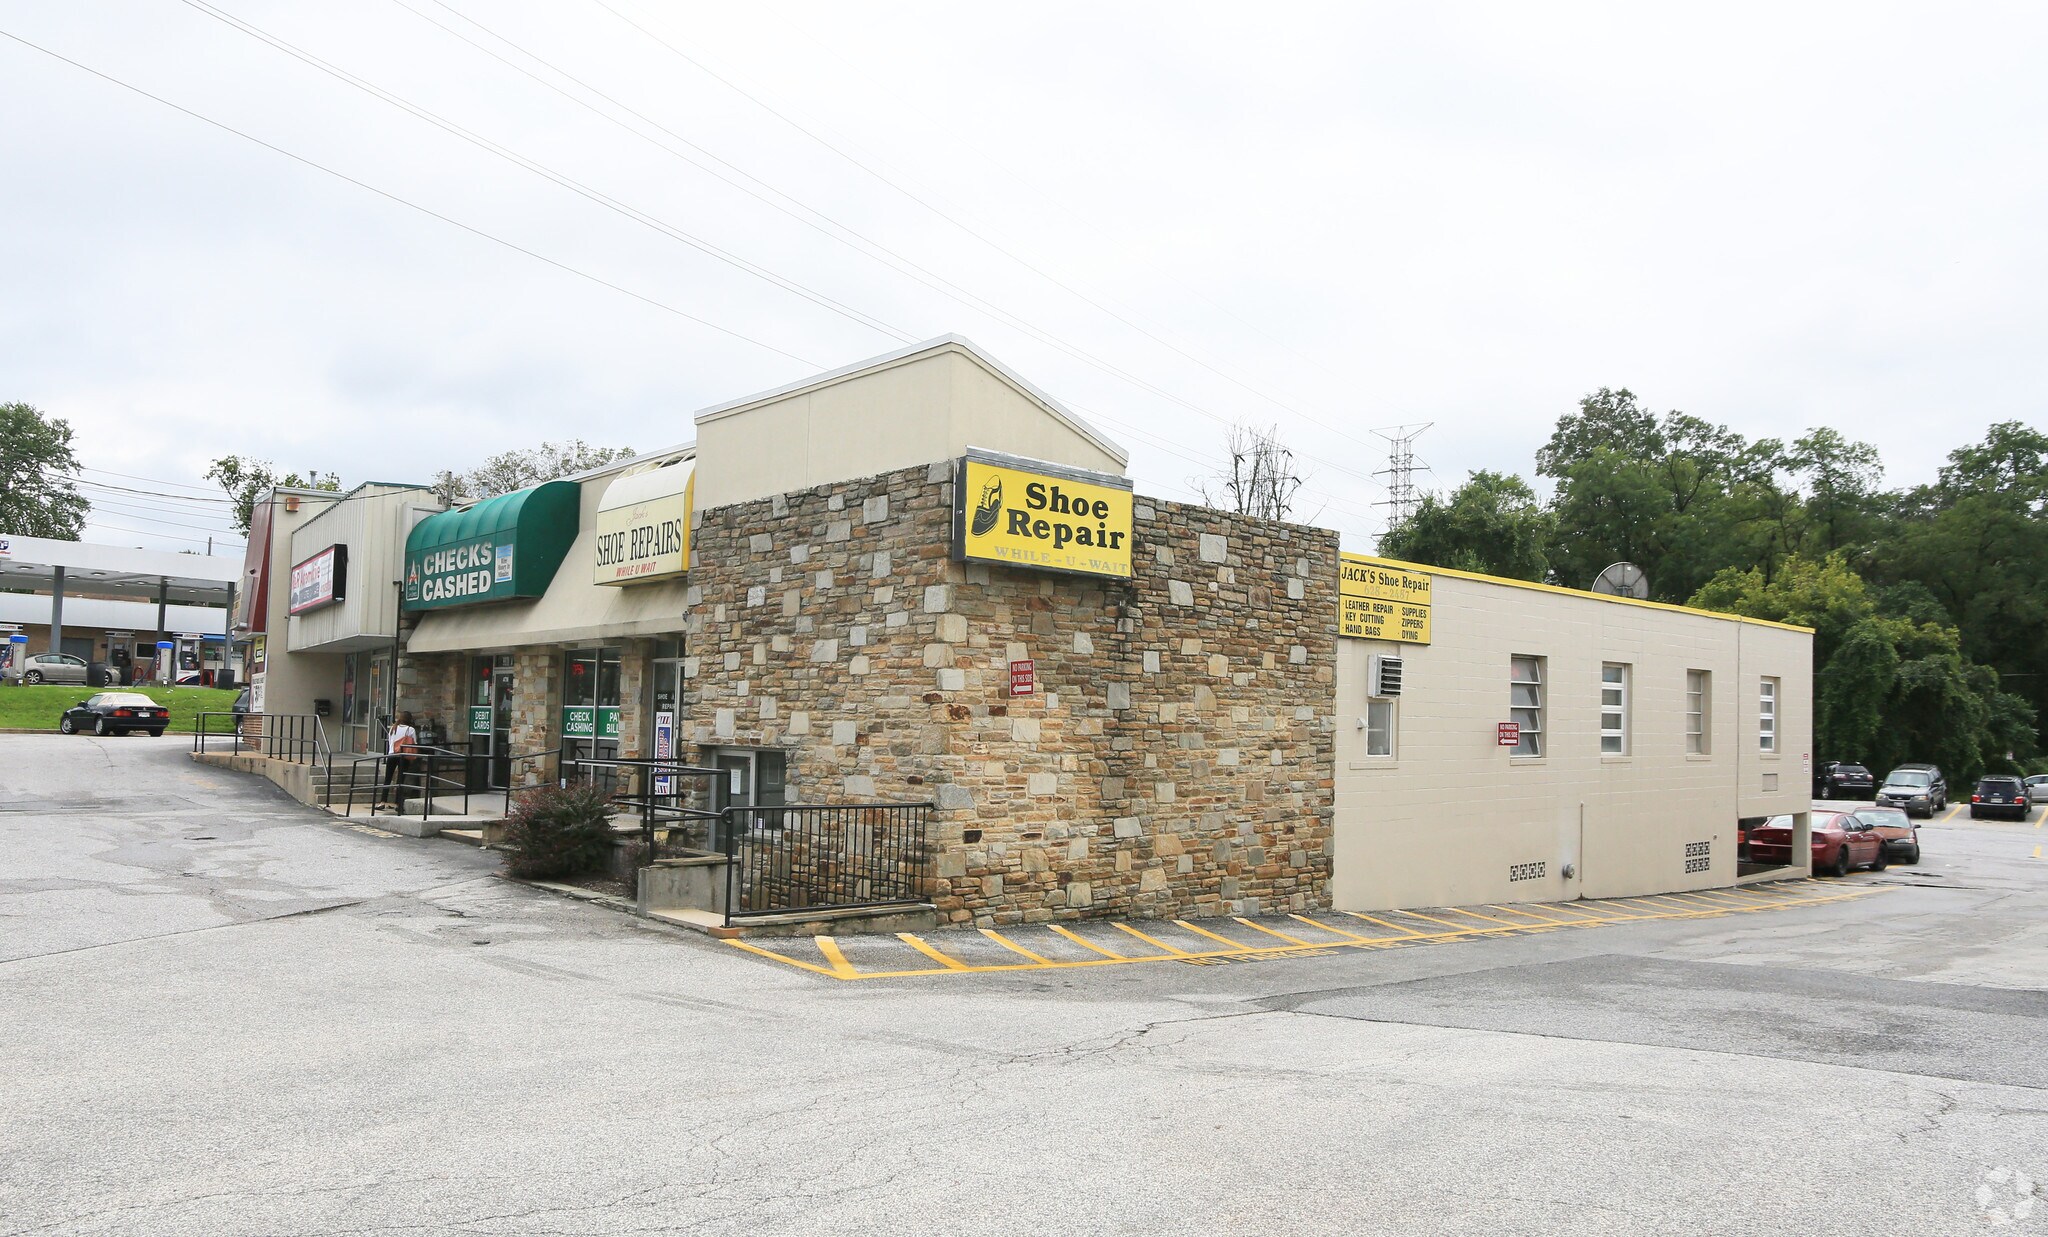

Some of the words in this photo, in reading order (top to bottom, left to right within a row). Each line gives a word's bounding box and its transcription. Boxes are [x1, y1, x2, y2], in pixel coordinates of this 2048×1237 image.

[1025, 482, 1109, 520] Shoe
[1006, 508, 1125, 550] Repair
[597, 532, 625, 567] SHOE
[630, 518, 682, 561] REPAIRS
[423, 541, 492, 576] CHECKS
[616, 565, 634, 577] WHILE
[641, 561, 657, 573] WAIT
[422, 570, 491, 601] CASHED
[1341, 567, 1376, 584] JACK'S
[1379, 573, 1399, 587] Shoe
[1402, 576, 1429, 593] Repair
[1345, 600, 1370, 612] LEATHER
[1373, 603, 1394, 614] REPAIR
[1402, 607, 1427, 618] SUPPLIES
[1345, 612, 1356, 622] KEY
[1360, 613, 1385, 625] CUTTING
[1402, 618, 1424, 630] ZIPPERS
[1345, 624, 1362, 634] HAND
[1365, 626, 1381, 636] BAGS
[1402, 630, 1418, 640] DYING
[474, 711, 489, 720] DEBIT
[569, 711, 590, 722] CHECK
[473, 721, 490, 730] CARDS
[566, 722, 593, 733] CASHING
